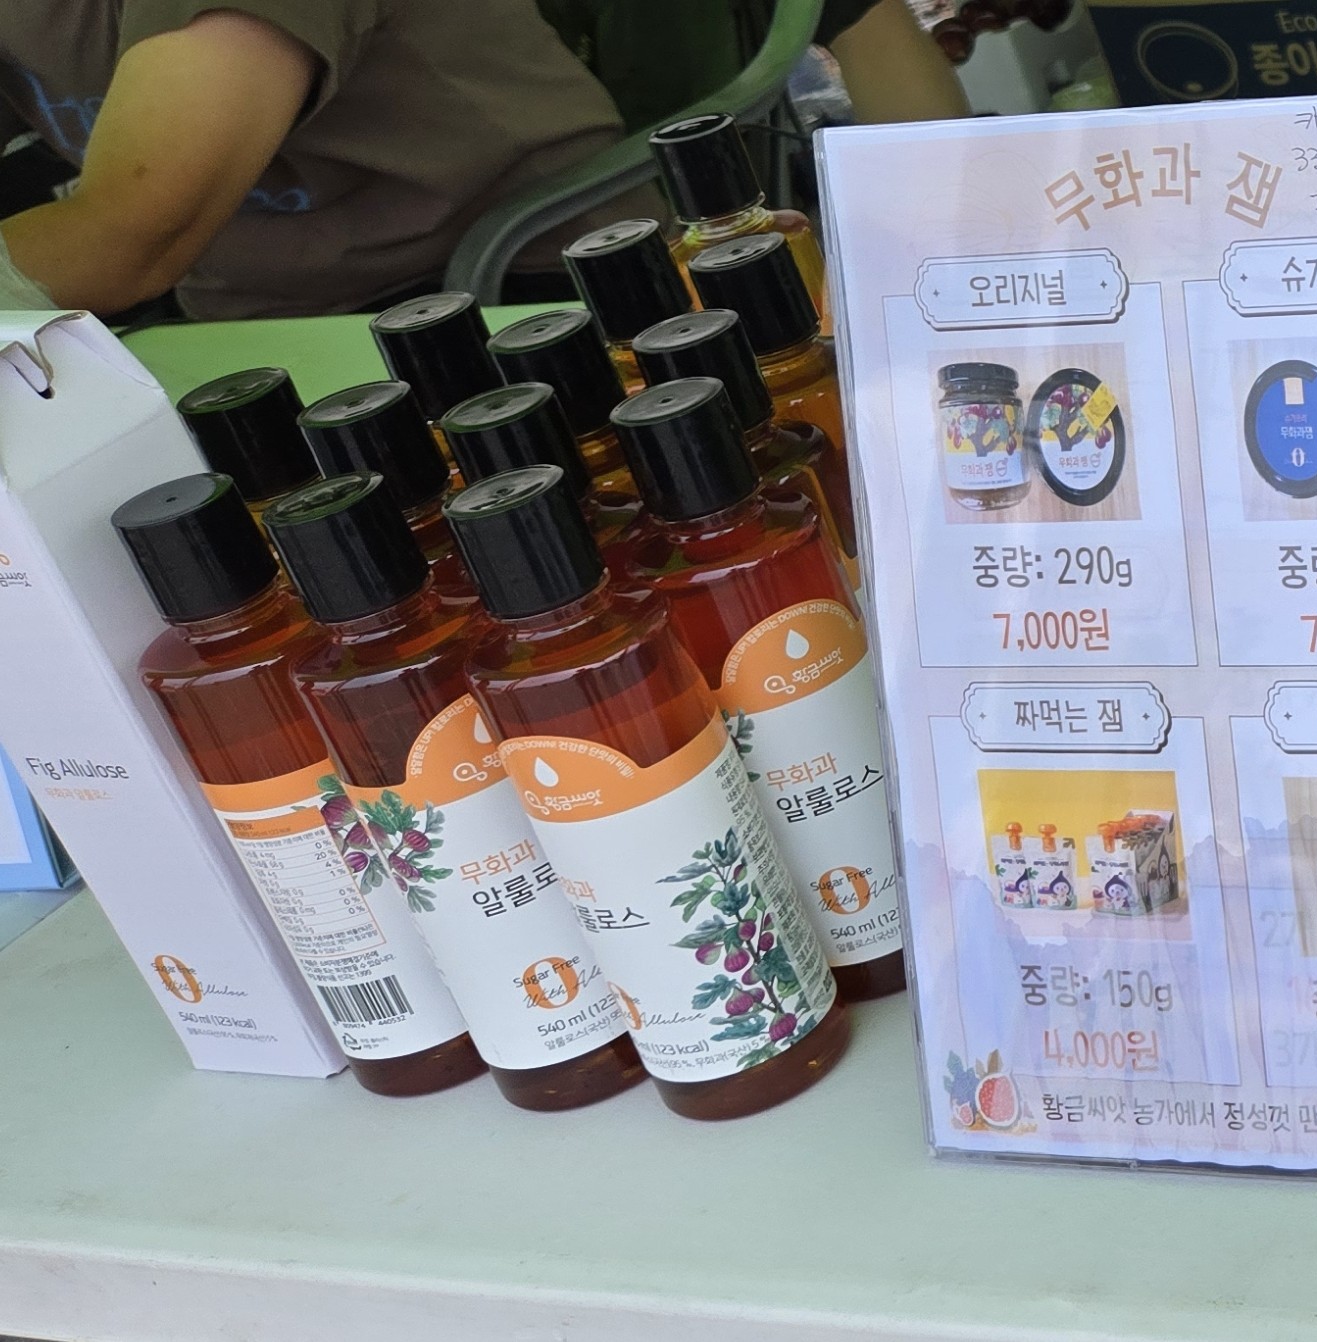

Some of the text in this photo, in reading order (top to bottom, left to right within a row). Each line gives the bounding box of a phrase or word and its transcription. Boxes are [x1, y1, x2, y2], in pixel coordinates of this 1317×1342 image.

[1044, 142, 1285, 231] 무화과 잼
[969, 268, 1067, 310] 오리지널
[1280, 426, 1314, 440] 무화과잼
[972, 543, 1134, 592] 중량: 290g
[777, 606, 808, 624] DOWN!
[992, 607, 1110, 656] 7,000원
[792, 646, 844, 684] 황금씨앗
[1013, 697, 1124, 735] 짜먹는 잼
[26, 757, 129, 780] Fig Allulose
[766, 752, 838, 791] 무화과
[776, 764, 884, 823] 알룰로스
[460, 840, 537, 885] 무화과
[810, 866, 873, 893] Sugar Free
[473, 862, 559, 918] 알룰로
[819, 865, 871, 915] 0
[830, 918, 876, 940] 540 ml
[513, 955, 581, 989] Sugar Free
[522, 956, 579, 1010] 0
[1019, 963, 1174, 1013] 중량: 150g
[179, 1011, 257, 1031] 540 (123 kcal)
[537, 1010, 588, 1037] 540 ml
[651, 1040, 709, 1056] (123 kcal)
[1042, 1028, 1161, 1074] 4,000원
[1041, 1093, 1129, 1124] 황금씨앗
[1133, 1098, 1217, 1129] 농가에서
[1223, 1099, 1292, 1134] 정성껏
